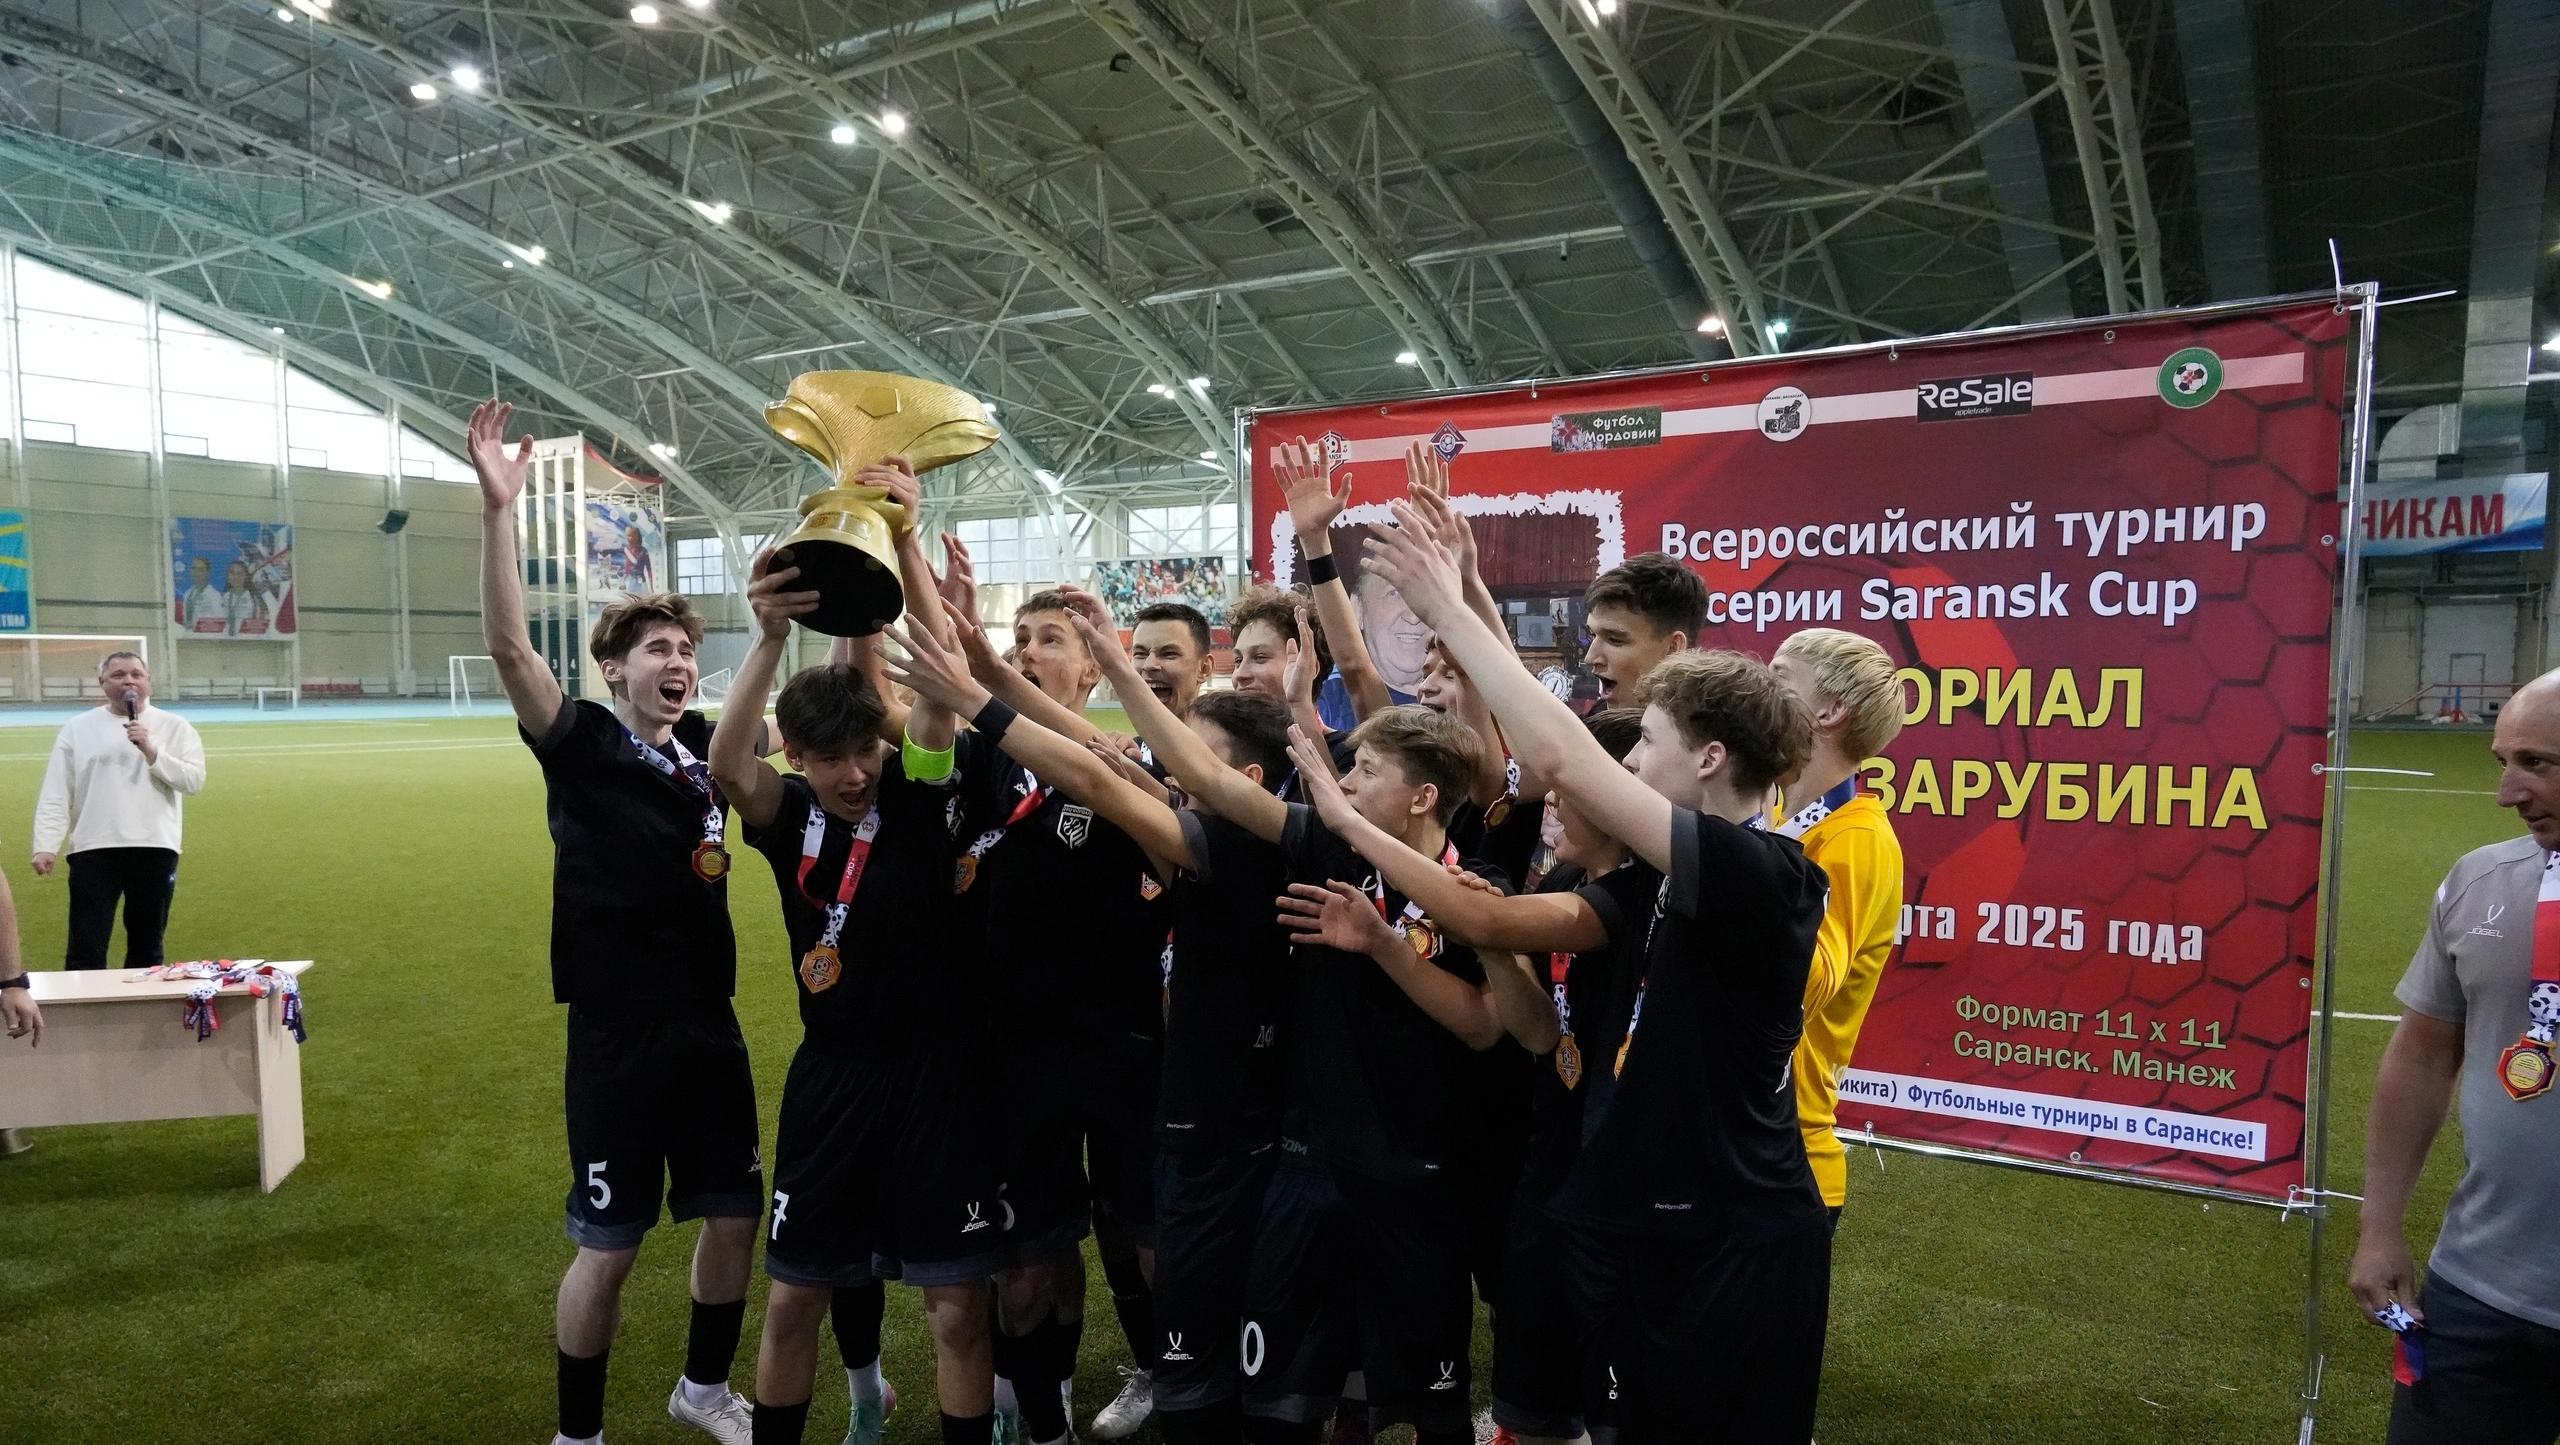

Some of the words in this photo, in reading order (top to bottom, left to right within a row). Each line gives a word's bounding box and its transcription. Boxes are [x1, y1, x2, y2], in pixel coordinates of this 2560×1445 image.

[1918, 377, 2032, 409] ReSale
[1954, 407, 1992, 416] appletrade
[1584, 428, 1656, 444] Мордовии
[1592, 414, 1645, 431] Футбол
[1661, 501, 2035, 570] Всероссийский
[2054, 501, 2266, 557] турнир
[1705, 590, 1842, 633] серии
[1859, 572, 2070, 621] Saransk
[2088, 570, 2198, 627] Cup
[1896, 667, 2143, 729] ОРИАЛ
[1860, 756, 2269, 830] ЗАРУБИНА
[1893, 902, 1955, 945] рта
[1977, 901, 2085, 951] 2025
[2108, 919, 2204, 965] года
[1955, 994, 2084, 1032] Формат
[2094, 1009, 2139, 1040] 11
[2179, 1018, 2227, 1049] 11
[1953, 1030, 2100, 1073] Саранск.
[2112, 1048, 2236, 1090] Манеж
[1839, 1078, 1898, 1103] икита)
[1907, 1084, 2026, 1118] Футбольные
[2031, 1104, 2118, 1132] турниры
[2126, 1118, 2138, 1133] в
[2144, 1116, 2254, 1150] Саранске!
[588, 1160, 611, 1209] 5
[771, 1189, 790, 1241] 7
[1240, 1318, 1265, 1376] 0
